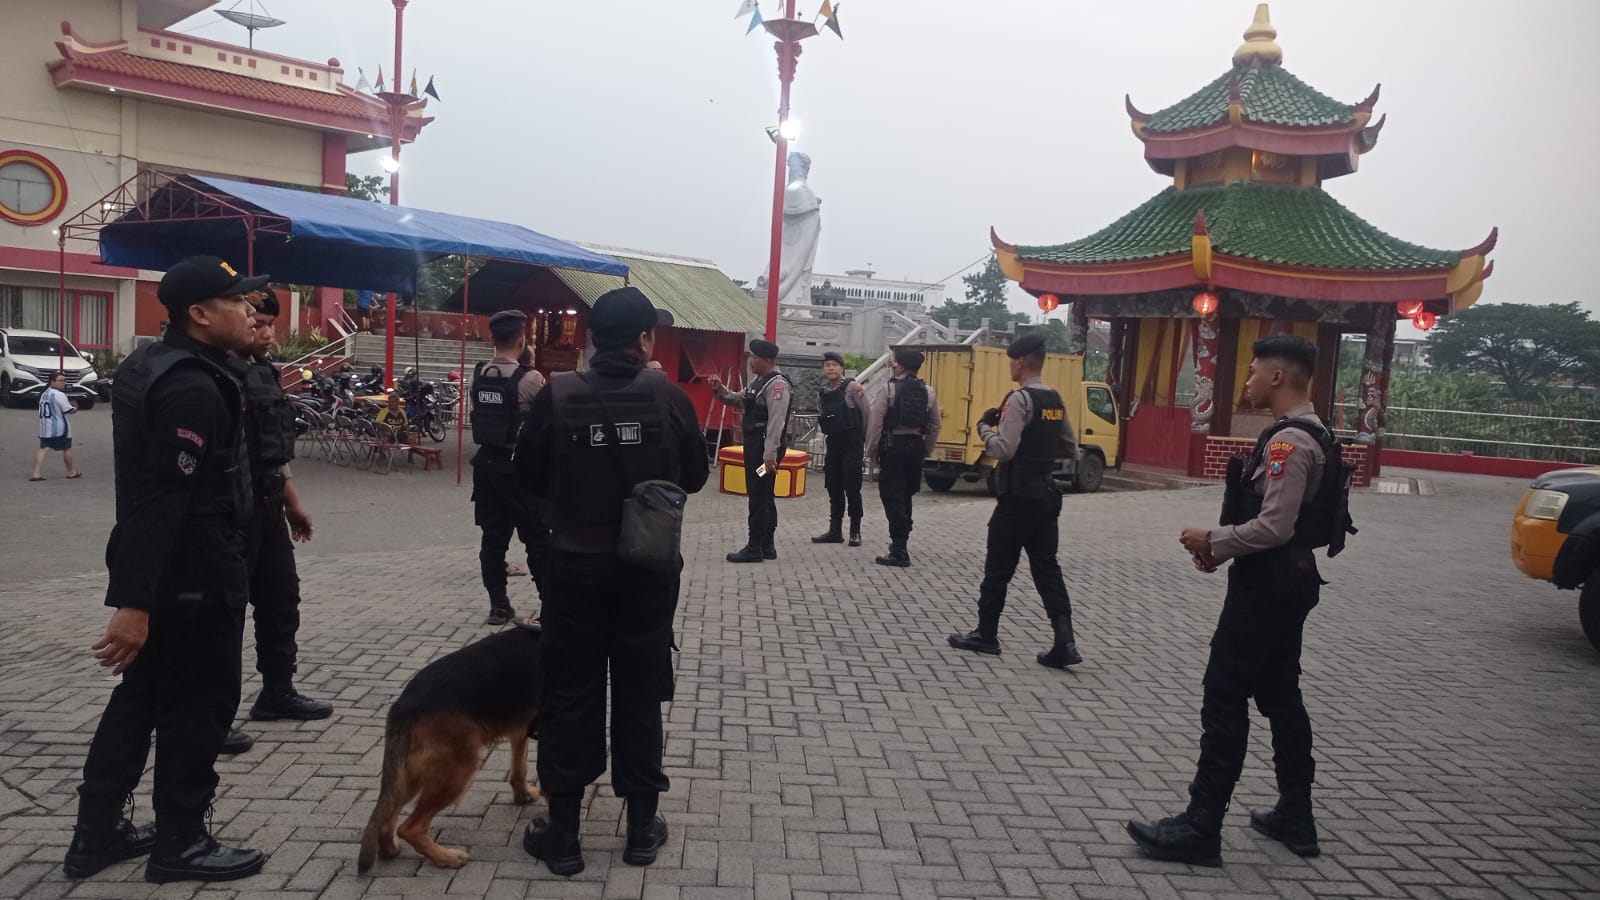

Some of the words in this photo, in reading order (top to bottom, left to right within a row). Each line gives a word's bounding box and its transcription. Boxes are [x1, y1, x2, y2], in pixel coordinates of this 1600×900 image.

[480, 392, 501, 402] POLISI
[1041, 408, 1063, 420] POLISI
[621, 426, 638, 440] UNIT
